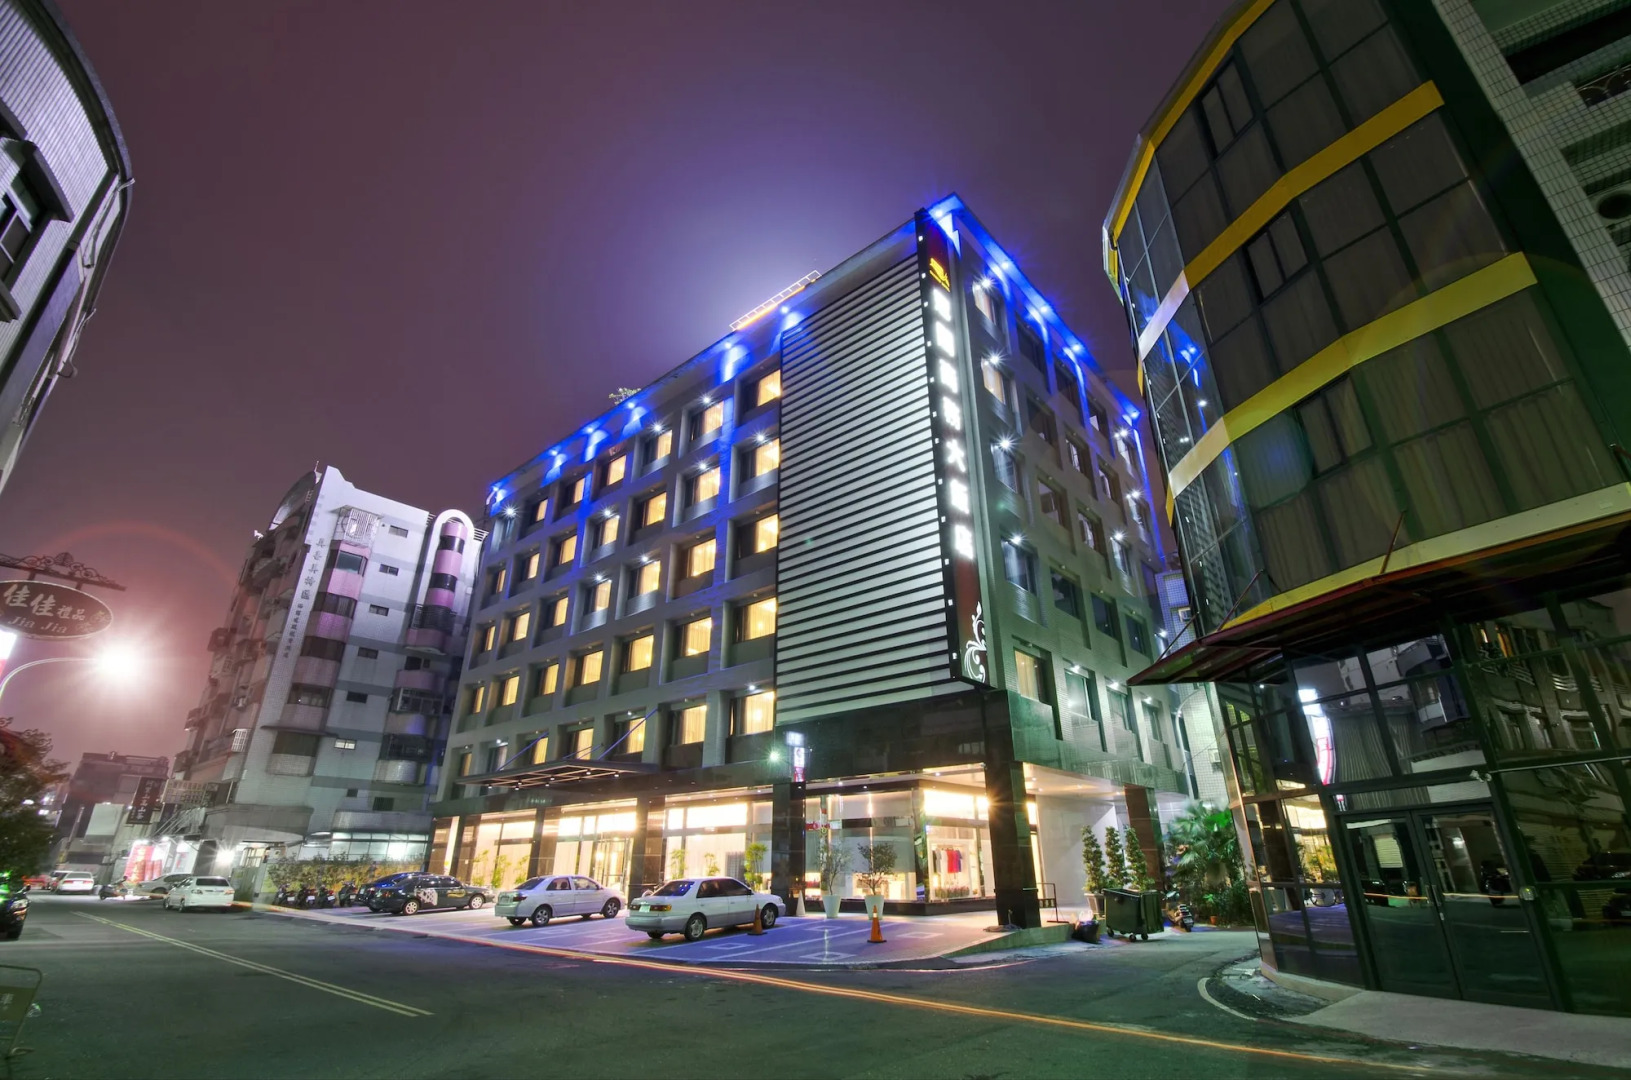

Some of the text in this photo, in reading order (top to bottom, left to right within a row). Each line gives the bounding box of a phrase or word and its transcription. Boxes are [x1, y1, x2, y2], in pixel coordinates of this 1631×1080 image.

[4, 585, 85, 620] 佳佳禮品
[8, 617, 67, 633] Jia Jia
